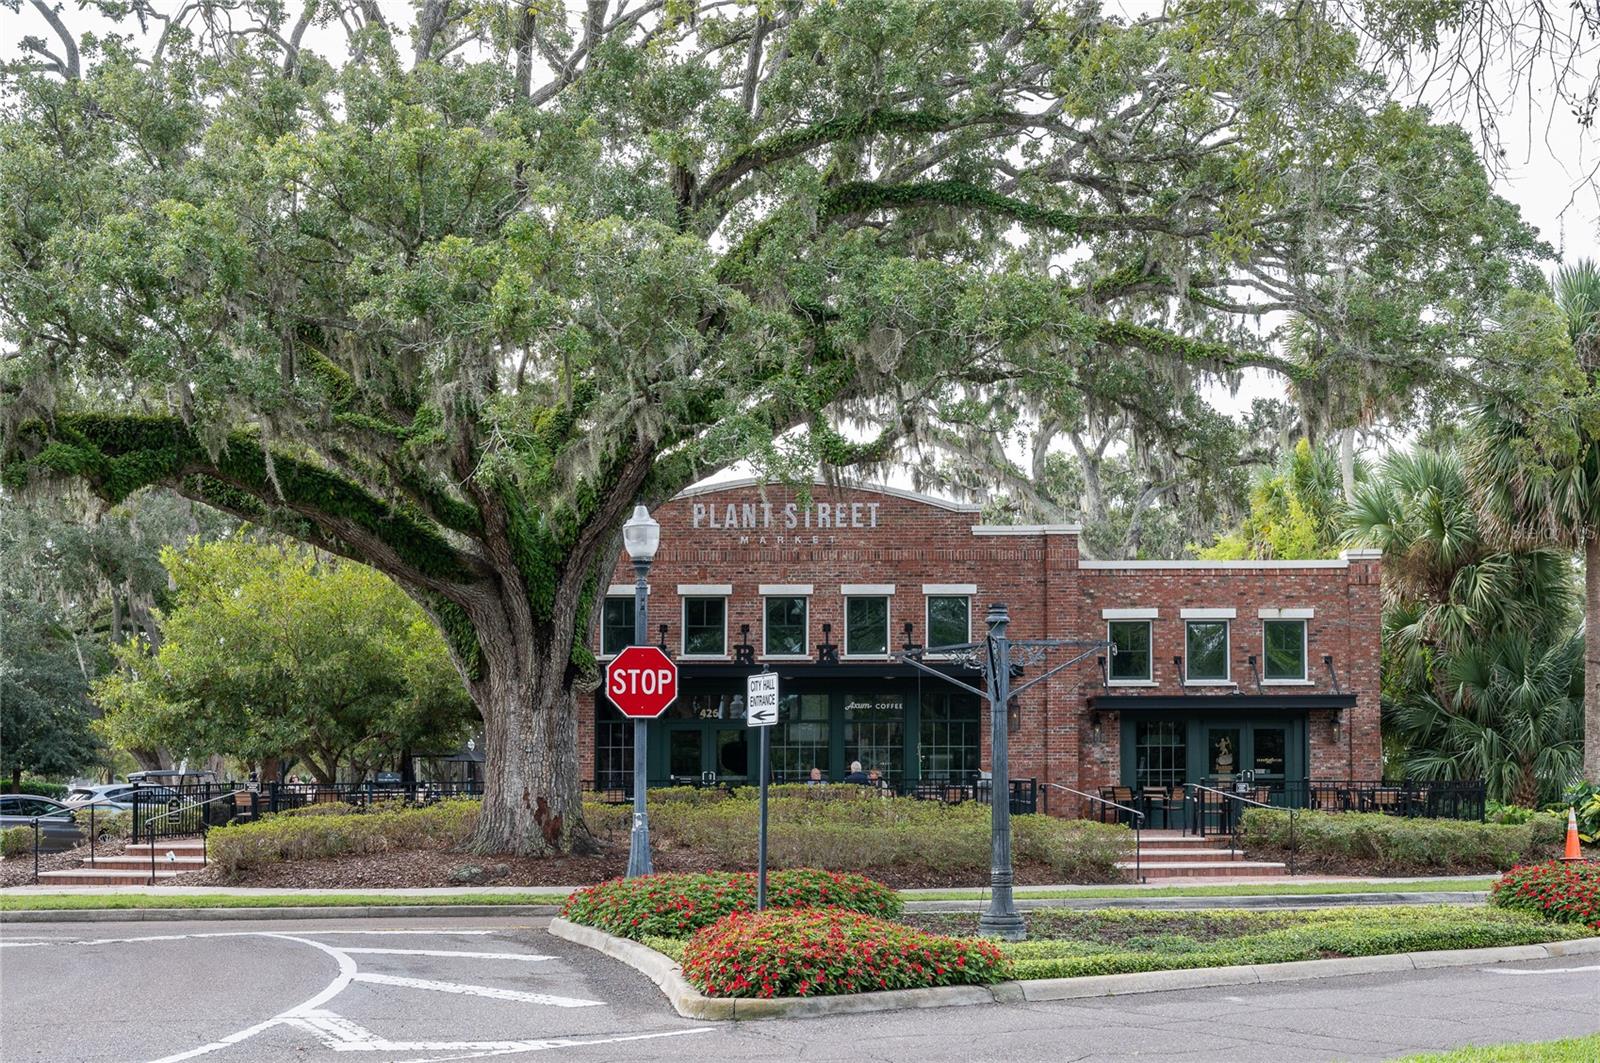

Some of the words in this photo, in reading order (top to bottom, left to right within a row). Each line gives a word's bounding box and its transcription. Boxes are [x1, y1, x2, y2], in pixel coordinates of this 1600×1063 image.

[693, 503, 773, 528] PLANT
[785, 502, 880, 528] STREET
[740, 535, 836, 545] MARKET
[612, 669, 673, 695] STOP
[750, 680, 762, 692] CITY
[763, 679, 775, 691] HALL
[750, 693, 775, 707] ENTRANCE
[699, 709, 719, 720] 426
